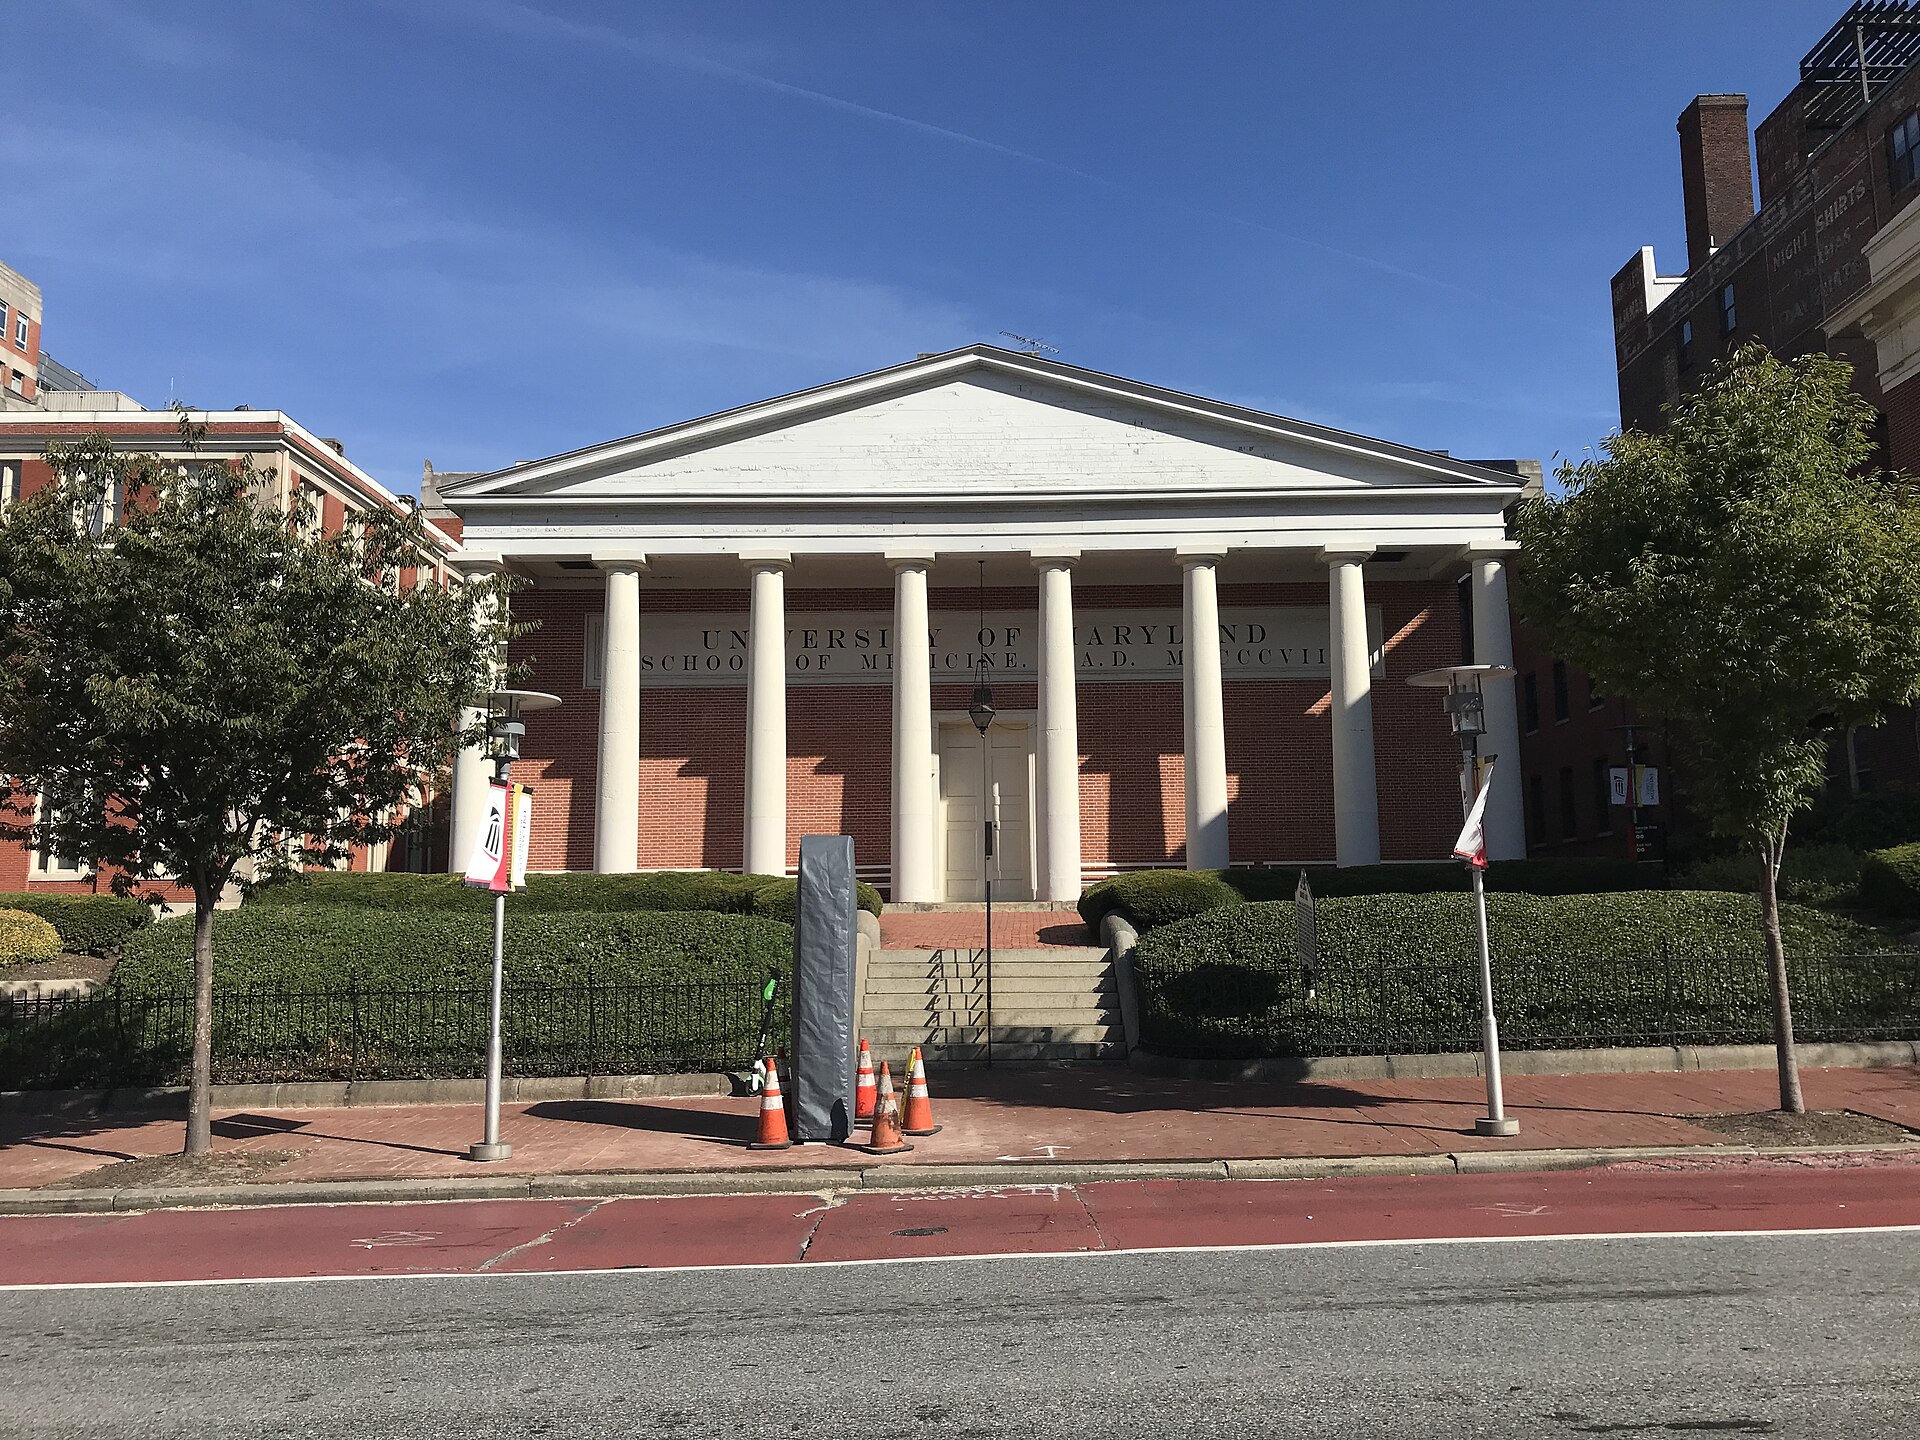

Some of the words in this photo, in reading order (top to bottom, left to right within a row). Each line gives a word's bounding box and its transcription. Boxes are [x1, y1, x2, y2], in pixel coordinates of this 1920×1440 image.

[1773, 228, 1808, 272] NIGHT
[1816, 179, 1865, 233] SHIRTS
[701, 628, 942, 650] UNERSIY
[977, 627, 1021, 647] OF
[1073, 624, 1266, 646] ARYLND
[641, 654, 744, 671] SCHOO
[795, 653, 831, 670] OF
[861, 652, 1026, 670] MEICINE.
[1081, 650, 1135, 667] A.D.
